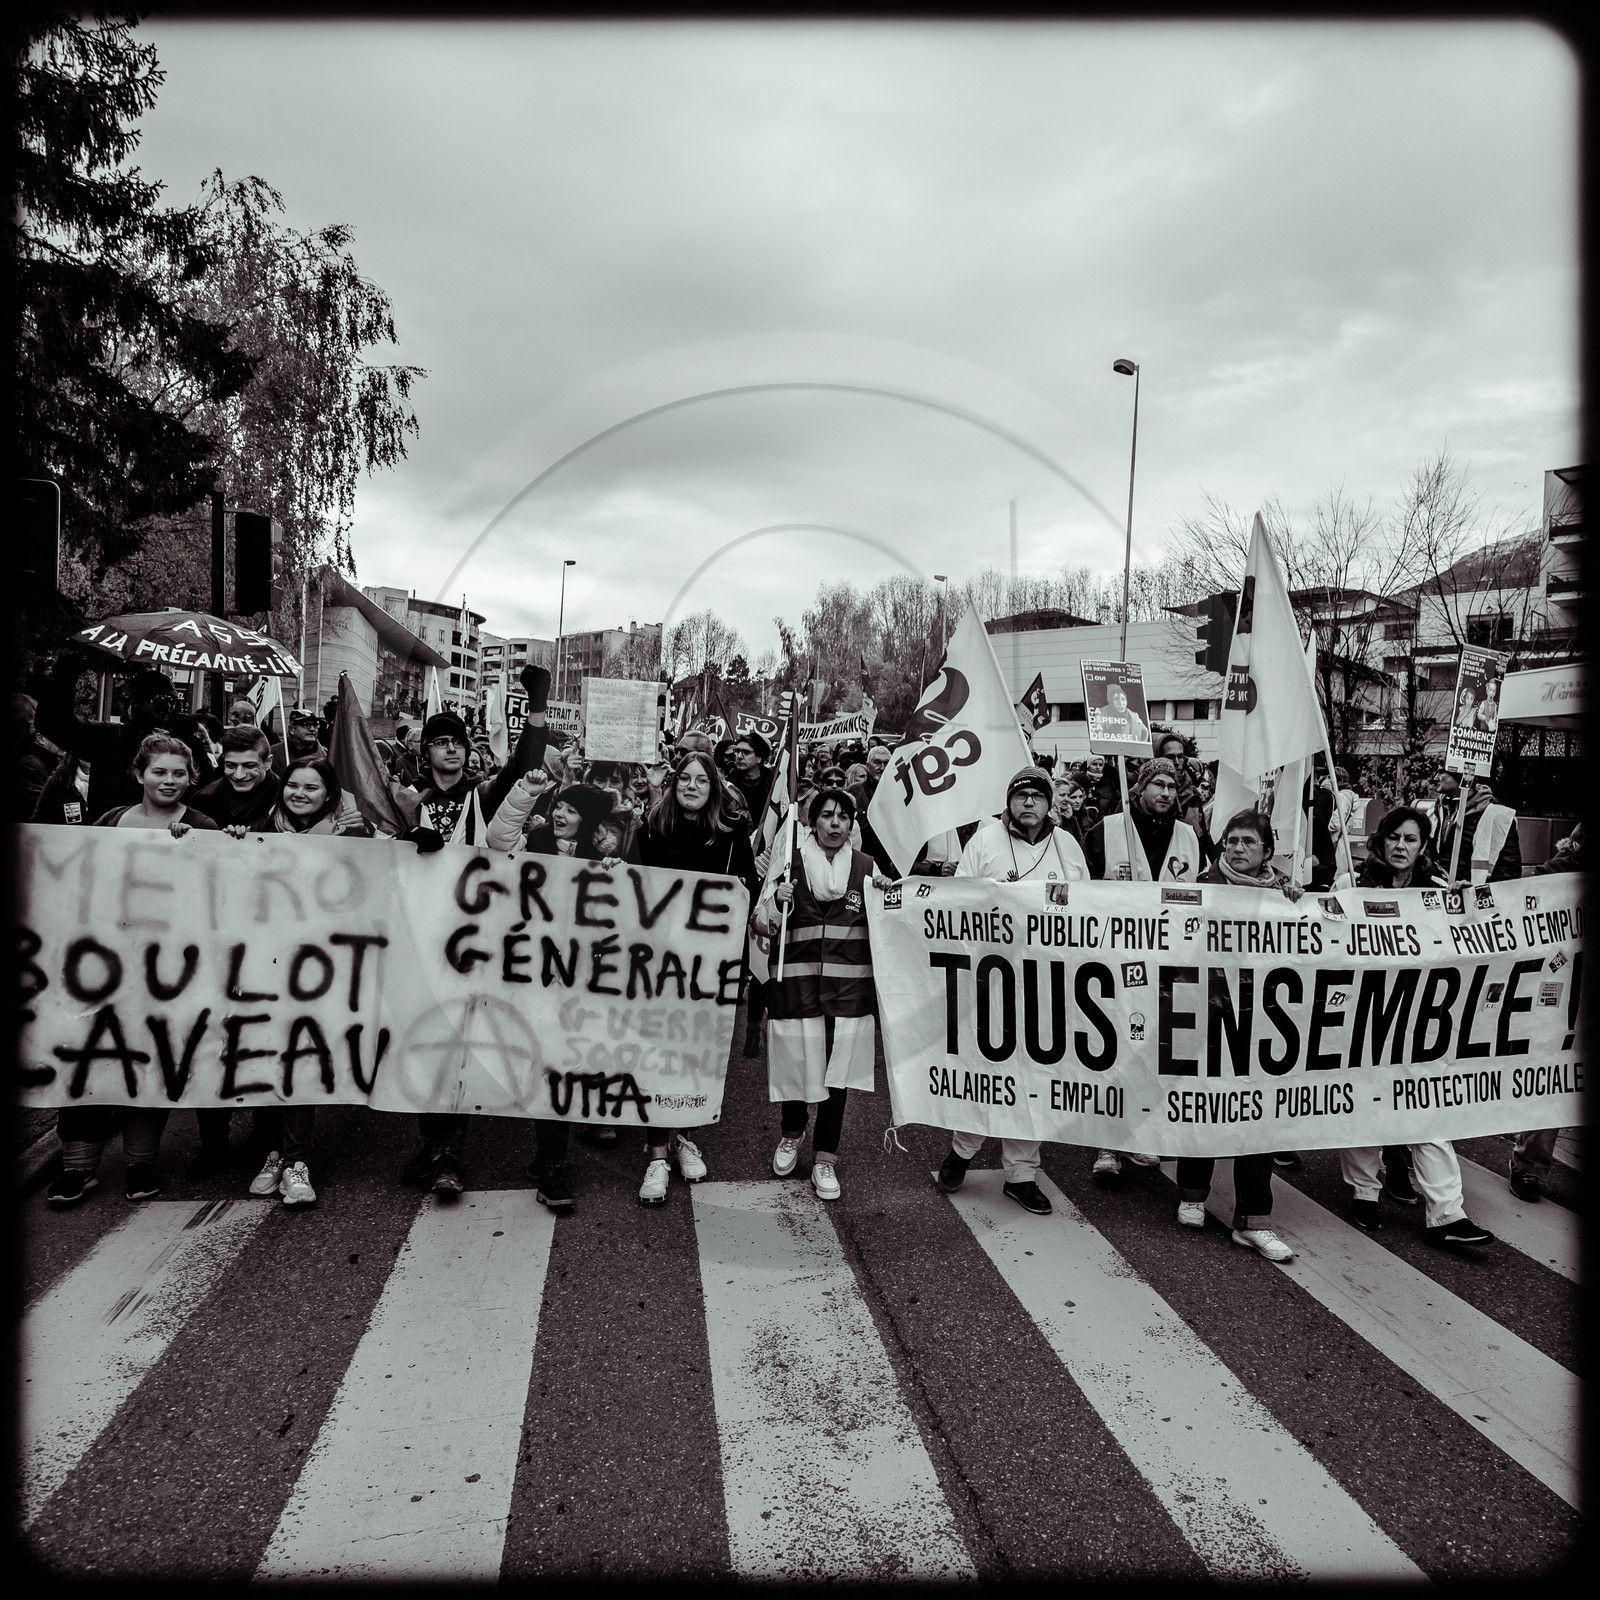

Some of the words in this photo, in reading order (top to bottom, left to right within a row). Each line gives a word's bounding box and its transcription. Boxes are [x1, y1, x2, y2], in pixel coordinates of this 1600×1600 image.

[99, 632, 128, 651] LA
[1089, 714, 1128, 725] DÉPEND
[799, 726, 821, 740] PITAL
[1091, 731, 1133, 741] DÉPASSE
[1451, 726, 1496, 743] COMMENCE
[1456, 738, 1494, 753] TRAVAILLER
[1474, 751, 1489, 762] ANS
[884, 890, 901, 903] cgt
[1423, 894, 1441, 906] cgt
[1446, 893, 1461, 909] FO
[1477, 895, 1494, 908] cgt
[923, 905, 1014, 946] SALARIÉS
[1026, 908, 1170, 951] PUBLIC/PRIVÉ
[1207, 914, 1322, 955] RETRAITÉS
[1347, 923, 1422, 956] JEUNES
[1450, 912, 1518, 956] PRIVÉS
[14, 924, 390, 1012] BOULOT
[444, 922, 747, 1006] GÉNÉRALE
[1126, 964, 1143, 982] FO
[558, 996, 734, 1048] GUERRE
[929, 951, 1118, 1072] TOUS
[1157, 957, 1546, 1078] ENSEMBLE
[1130, 1030, 1145, 1040] cgt
[928, 1066, 1016, 1107] SALAIRES
[1050, 1079, 1124, 1119] EMPLOI
[1167, 1089, 1263, 1125] SERVICES
[1275, 1083, 1355, 1119] PUBLICS
[1393, 1070, 1502, 1111] PROTECTION
[1512, 1062, 1584, 1099] SOCIALE
